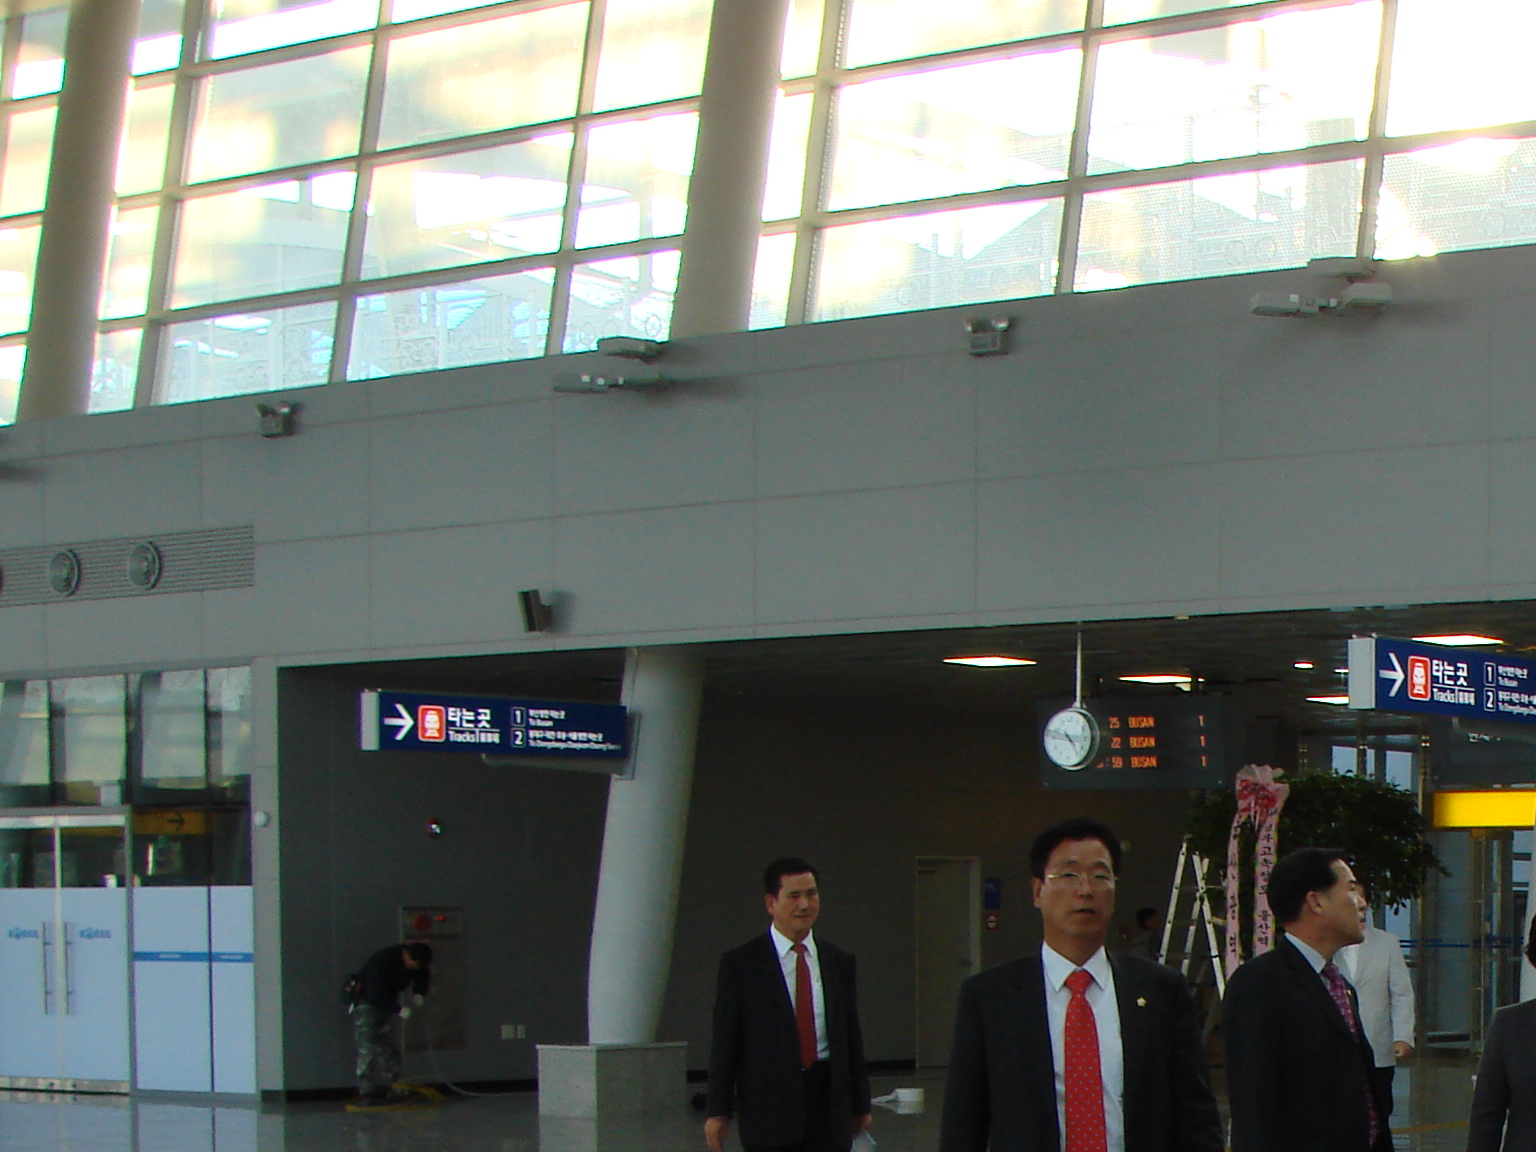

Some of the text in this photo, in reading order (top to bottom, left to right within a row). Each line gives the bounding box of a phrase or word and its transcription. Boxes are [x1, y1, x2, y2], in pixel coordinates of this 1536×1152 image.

[1432, 659, 1454, 686] 타는
[1456, 662, 1468, 687] 곳
[447, 707, 492, 728] 타는 곳
[1128, 716, 1155, 729] BUSAN
[1129, 736, 1156, 748] BUSAN
[1130, 755, 1158, 768] BUSAN
